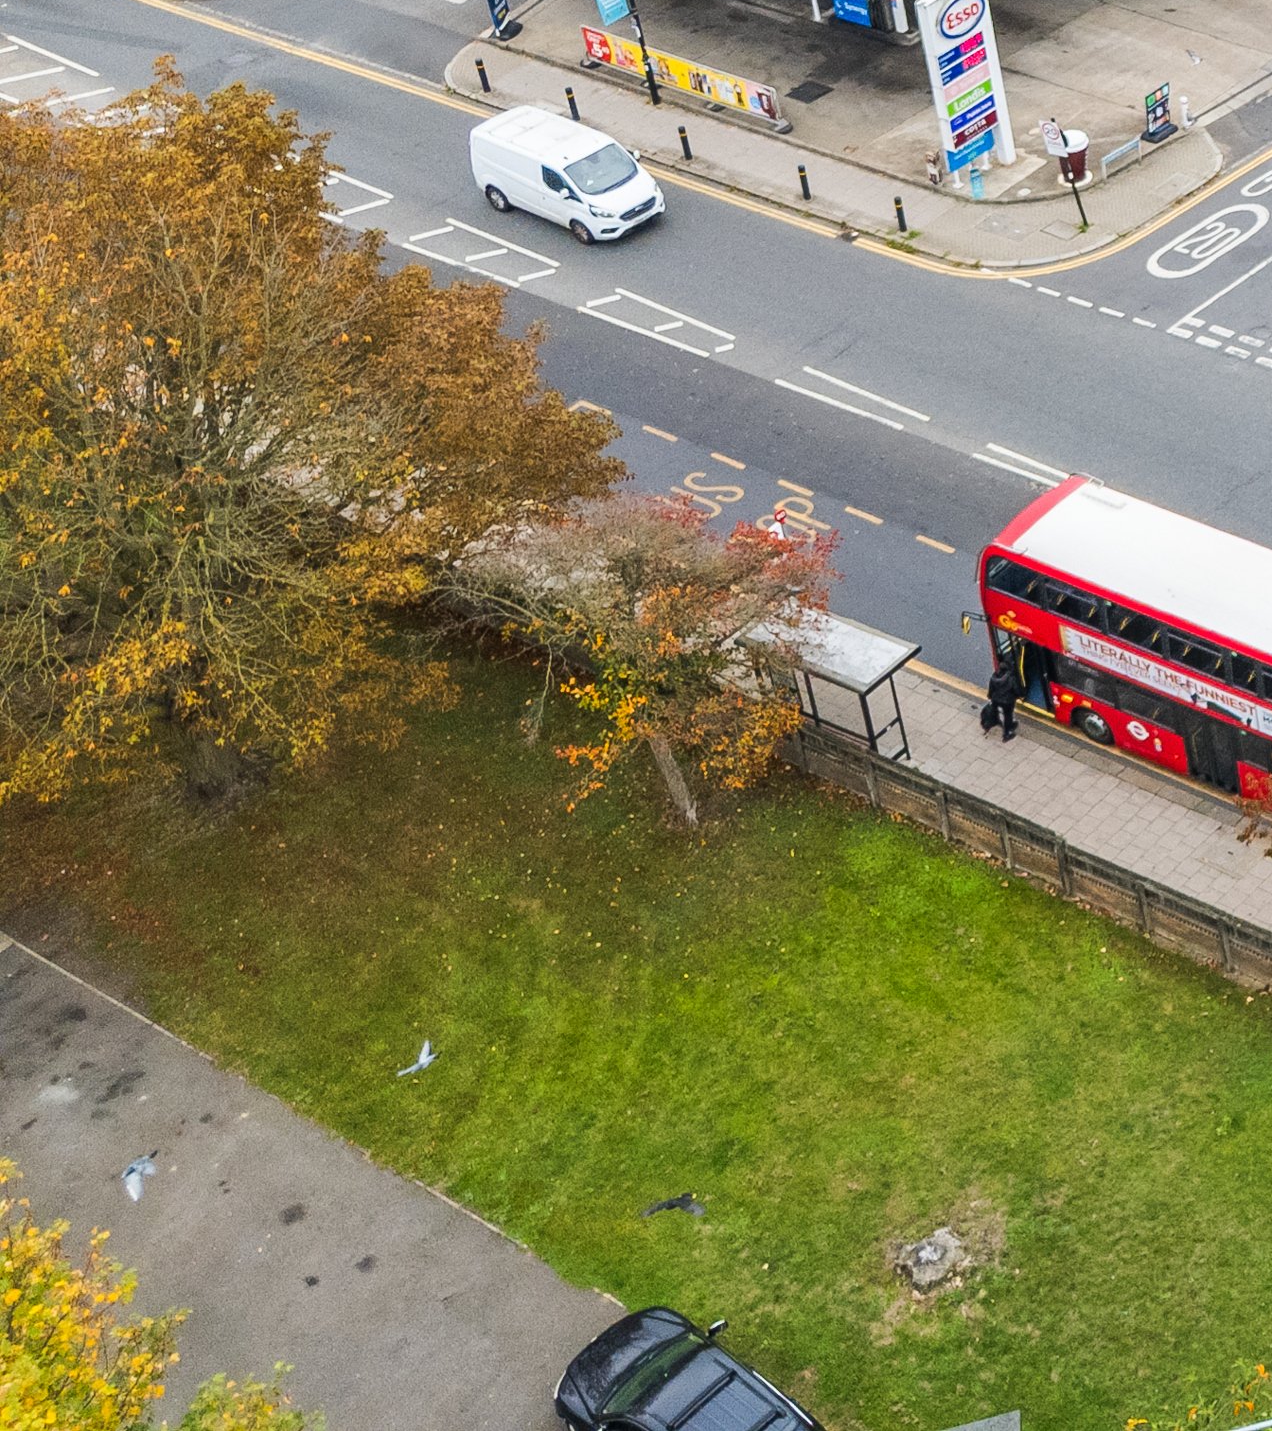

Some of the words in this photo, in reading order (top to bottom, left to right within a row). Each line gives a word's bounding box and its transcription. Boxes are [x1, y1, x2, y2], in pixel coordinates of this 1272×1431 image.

[953, 87, 986, 112] Londis
[1174, 221, 1242, 260] 20
[1154, 668, 1183, 686] THE
[1184, 679, 1257, 718] FUNNIEST
